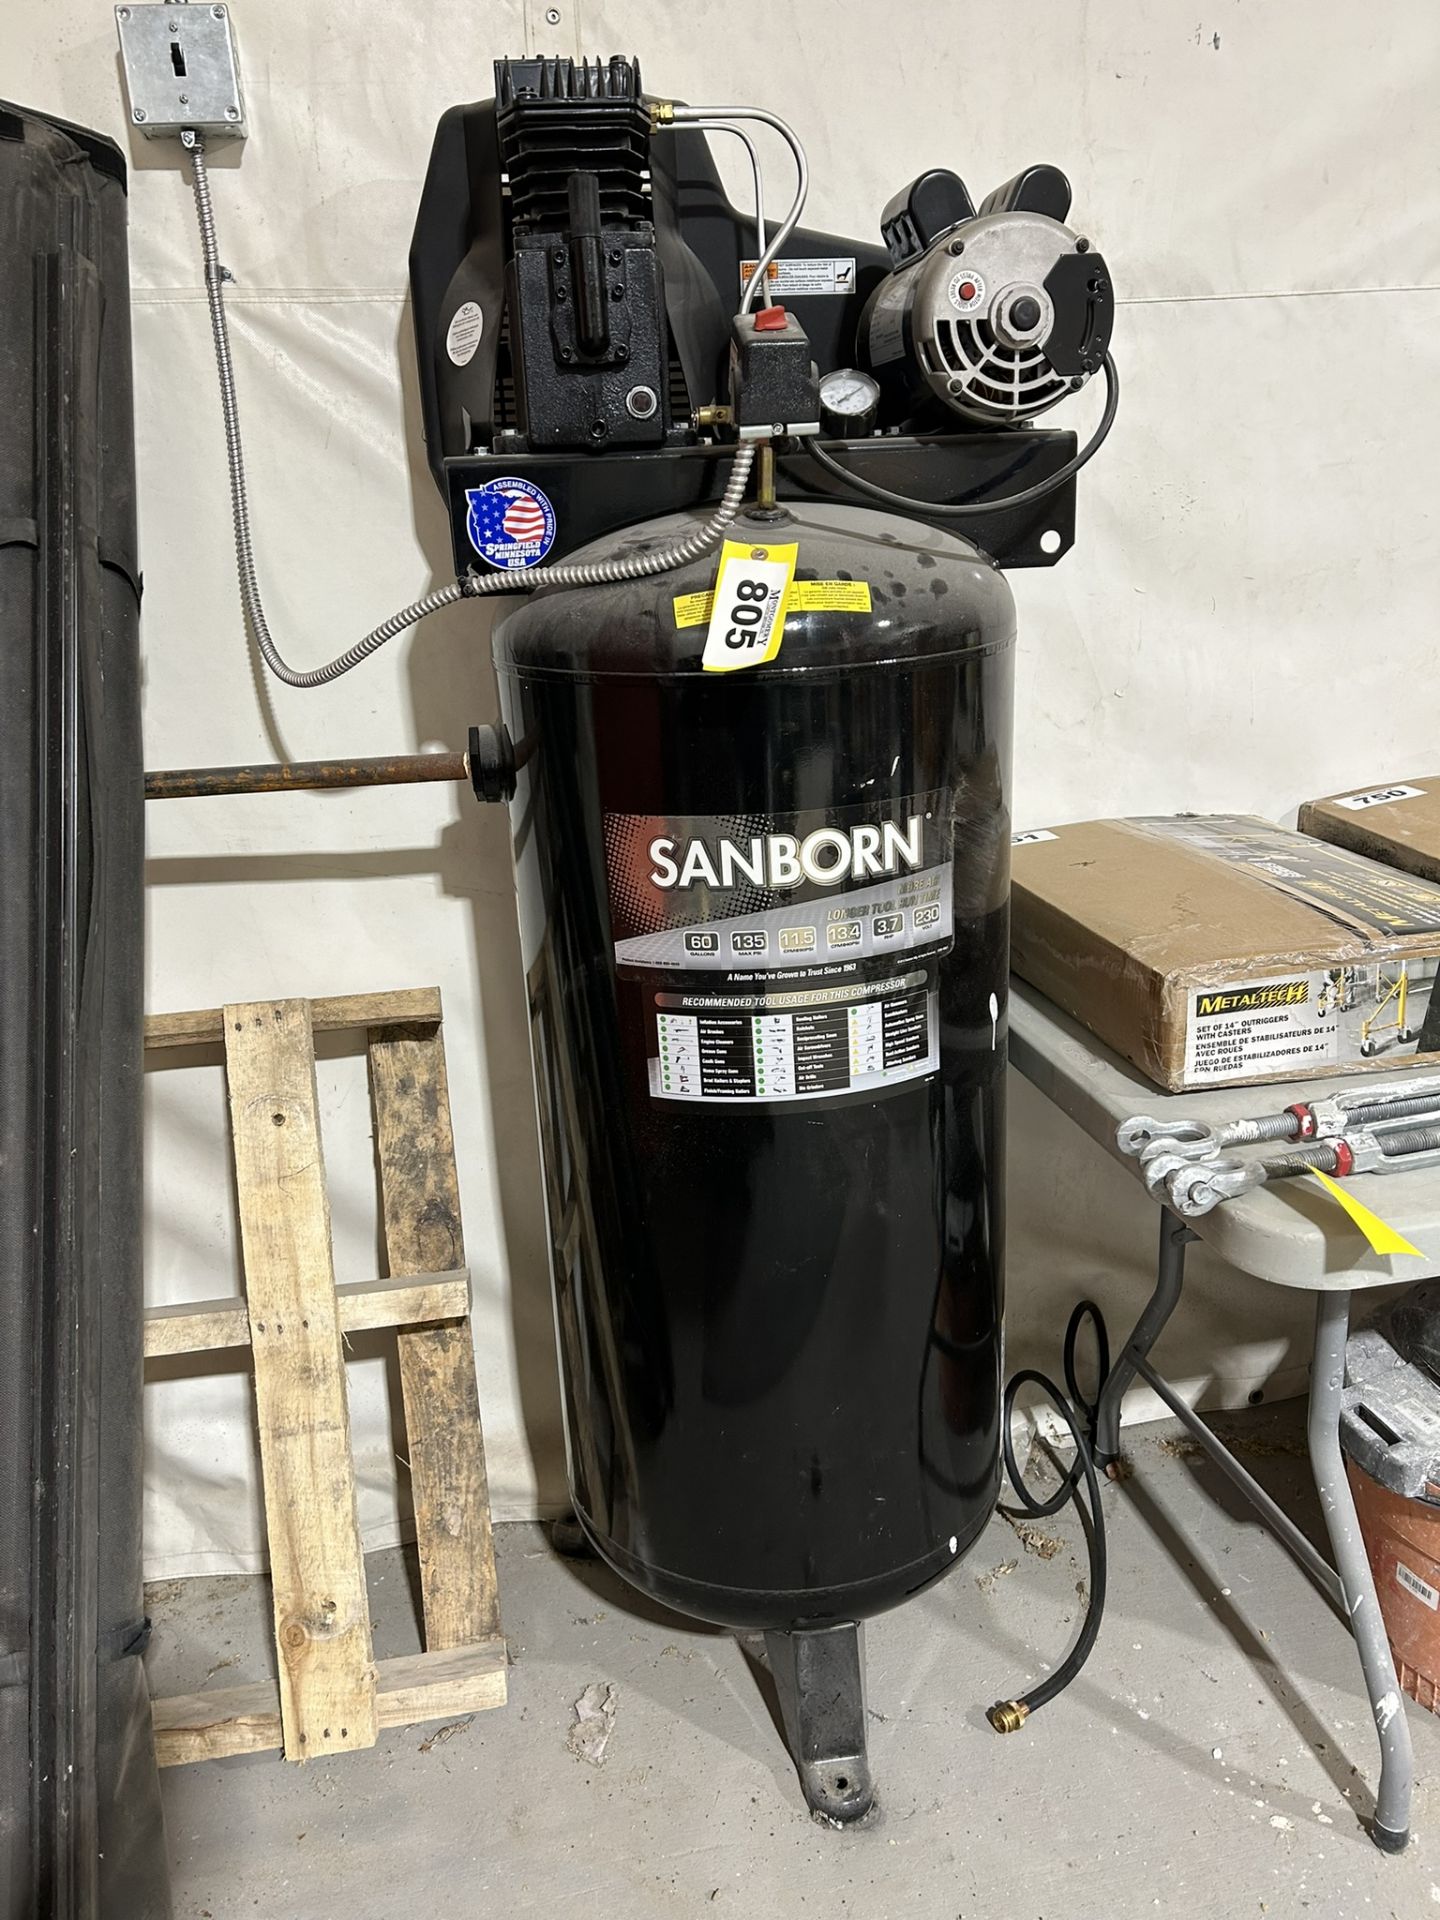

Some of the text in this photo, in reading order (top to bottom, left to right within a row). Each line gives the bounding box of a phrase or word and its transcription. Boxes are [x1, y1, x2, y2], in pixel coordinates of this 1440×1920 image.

[493, 481, 553, 546] ASSEMBLED WITH PRIDE IN
[485, 541, 541, 556] SPRINGFIELD
[494, 548, 541, 560] MINNESOTA
[507, 557, 526, 567] USA
[725, 580, 769, 650] 805
[757, 589, 781, 646] MONTGOMERY
[1353, 790, 1407, 804] 750
[649, 815, 923, 889] SANBORN
[916, 907, 939, 925] 230
[828, 925, 860, 941] 13.4
[877, 917, 899, 933] 3.7
[691, 936, 712, 949] 60
[733, 935, 765, 949] 135
[781, 930, 814, 946] 11.5
[727, 973, 733, 981] A
[734, 973, 754, 982] Name
[754, 971, 776, 981] You've
[777, 970, 799, 980] Grown
[799, 969, 807, 978] to
[807, 967, 824, 977] Trust
[823, 966, 842, 976] Since
[682, 978, 906, 1007] RECOMMENDED TOOL USAGE FOR THIS COMPRESSOR
[1200, 985, 1305, 1014] METALTECH
[1196, 1024, 1211, 1034] SET
[1213, 1023, 1223, 1031] OF
[1241, 1014, 1289, 1027] OUTRIGGERS
[1195, 1038, 1237, 1051] ENSEMBLE
[1239, 1037, 1249, 1045] DE
[1251, 1029, 1313, 1044] STABILISATEURS
[1313, 1026, 1325, 1035] DE
[1196, 1027, 1252, 1041] WITH CASTERS
[1194, 1058, 1220, 1067] JUEGO
[1221, 1056, 1232, 1064] DE
[1233, 1047, 1301, 1062] ESTABILIZADORES
[1303, 1045, 1313, 1053] DE
[1195, 1045, 1244, 1058] AVEC ROUES
[1213, 1062, 1243, 1072] RUEDAS
